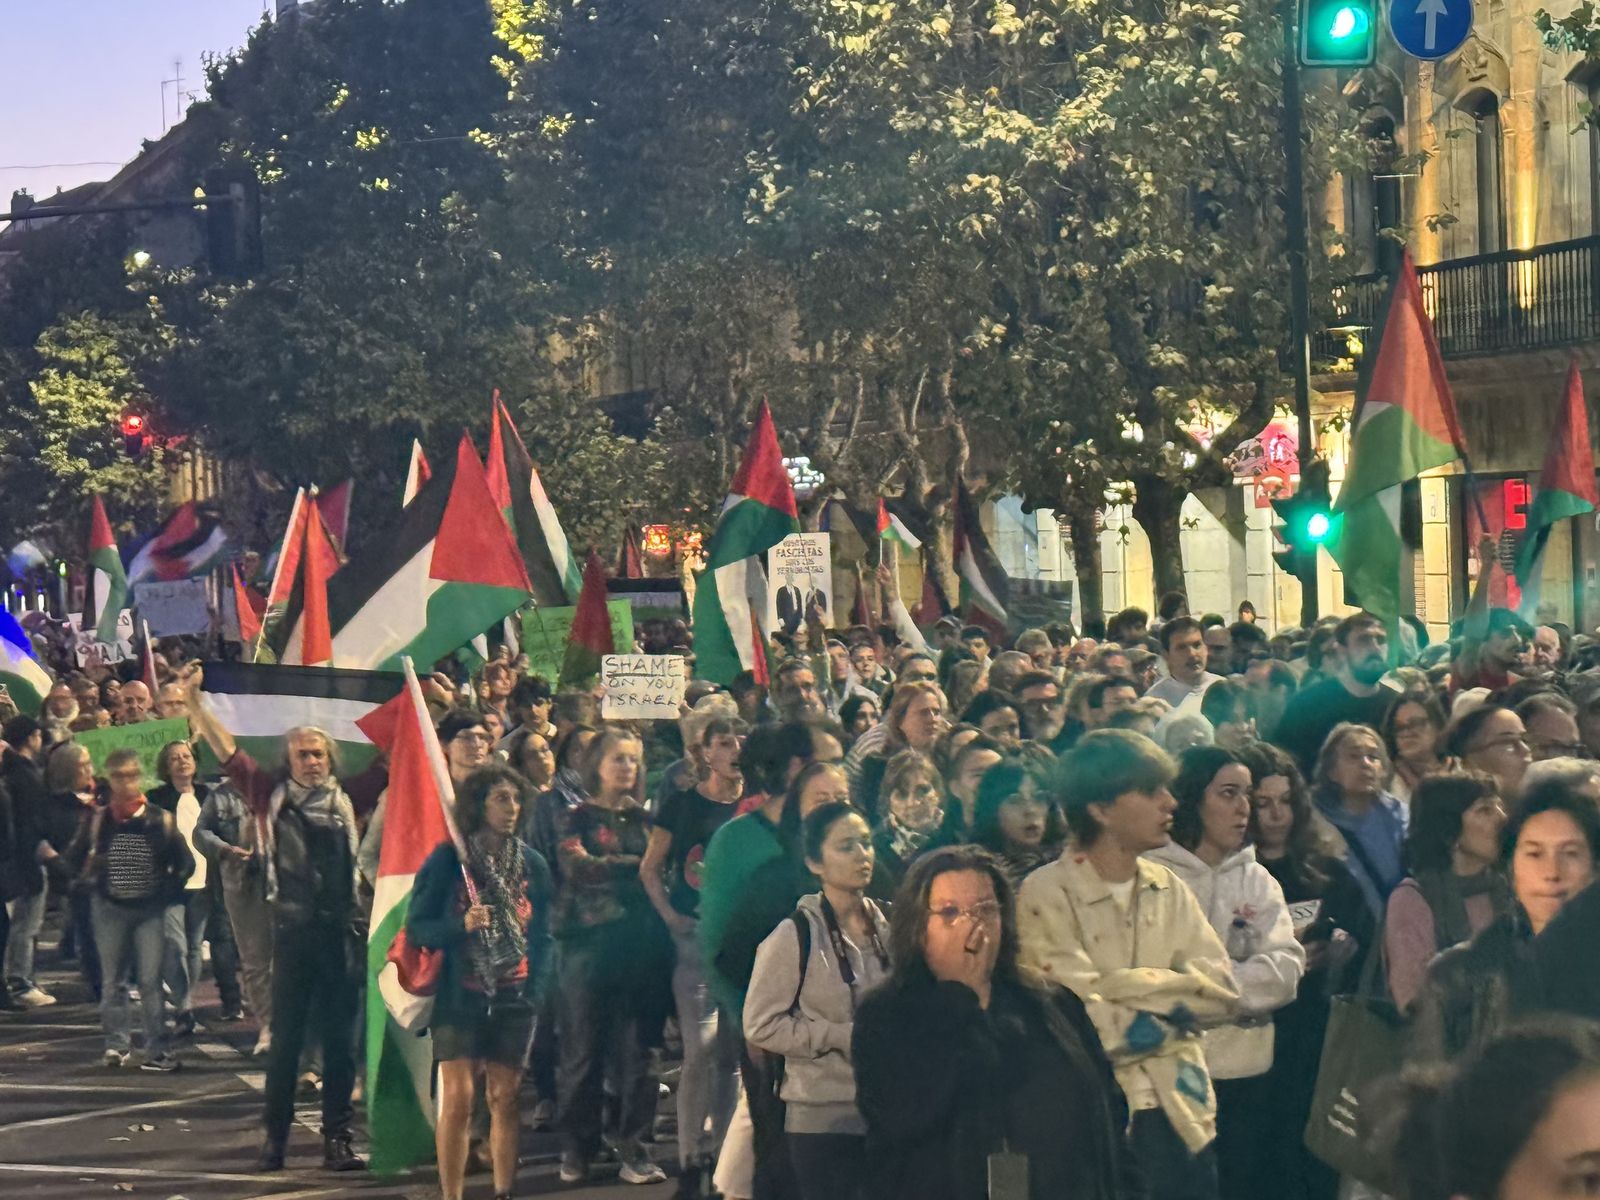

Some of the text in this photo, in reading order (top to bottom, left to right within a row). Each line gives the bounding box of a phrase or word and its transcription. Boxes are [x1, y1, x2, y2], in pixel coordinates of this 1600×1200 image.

[606, 657, 685, 677] SHAME
[608, 678, 635, 689] ON
[608, 693, 677, 707] ISRAEL
